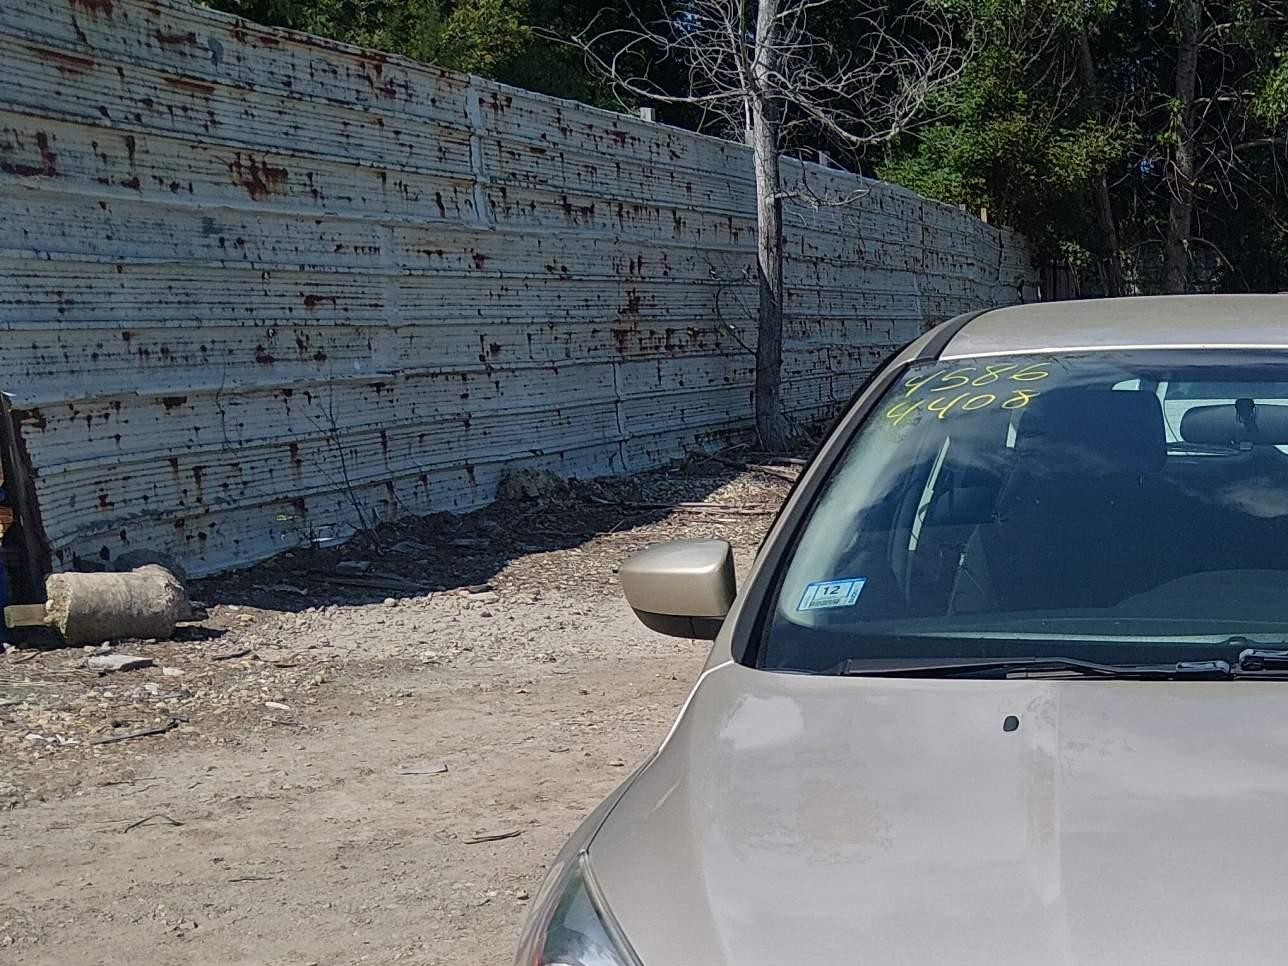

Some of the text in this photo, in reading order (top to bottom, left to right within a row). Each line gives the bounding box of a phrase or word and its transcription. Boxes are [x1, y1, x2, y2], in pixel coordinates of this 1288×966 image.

[905, 362, 1051, 397] 4586
[886, 389, 1041, 426] 4408
[823, 585, 841, 596] 12
